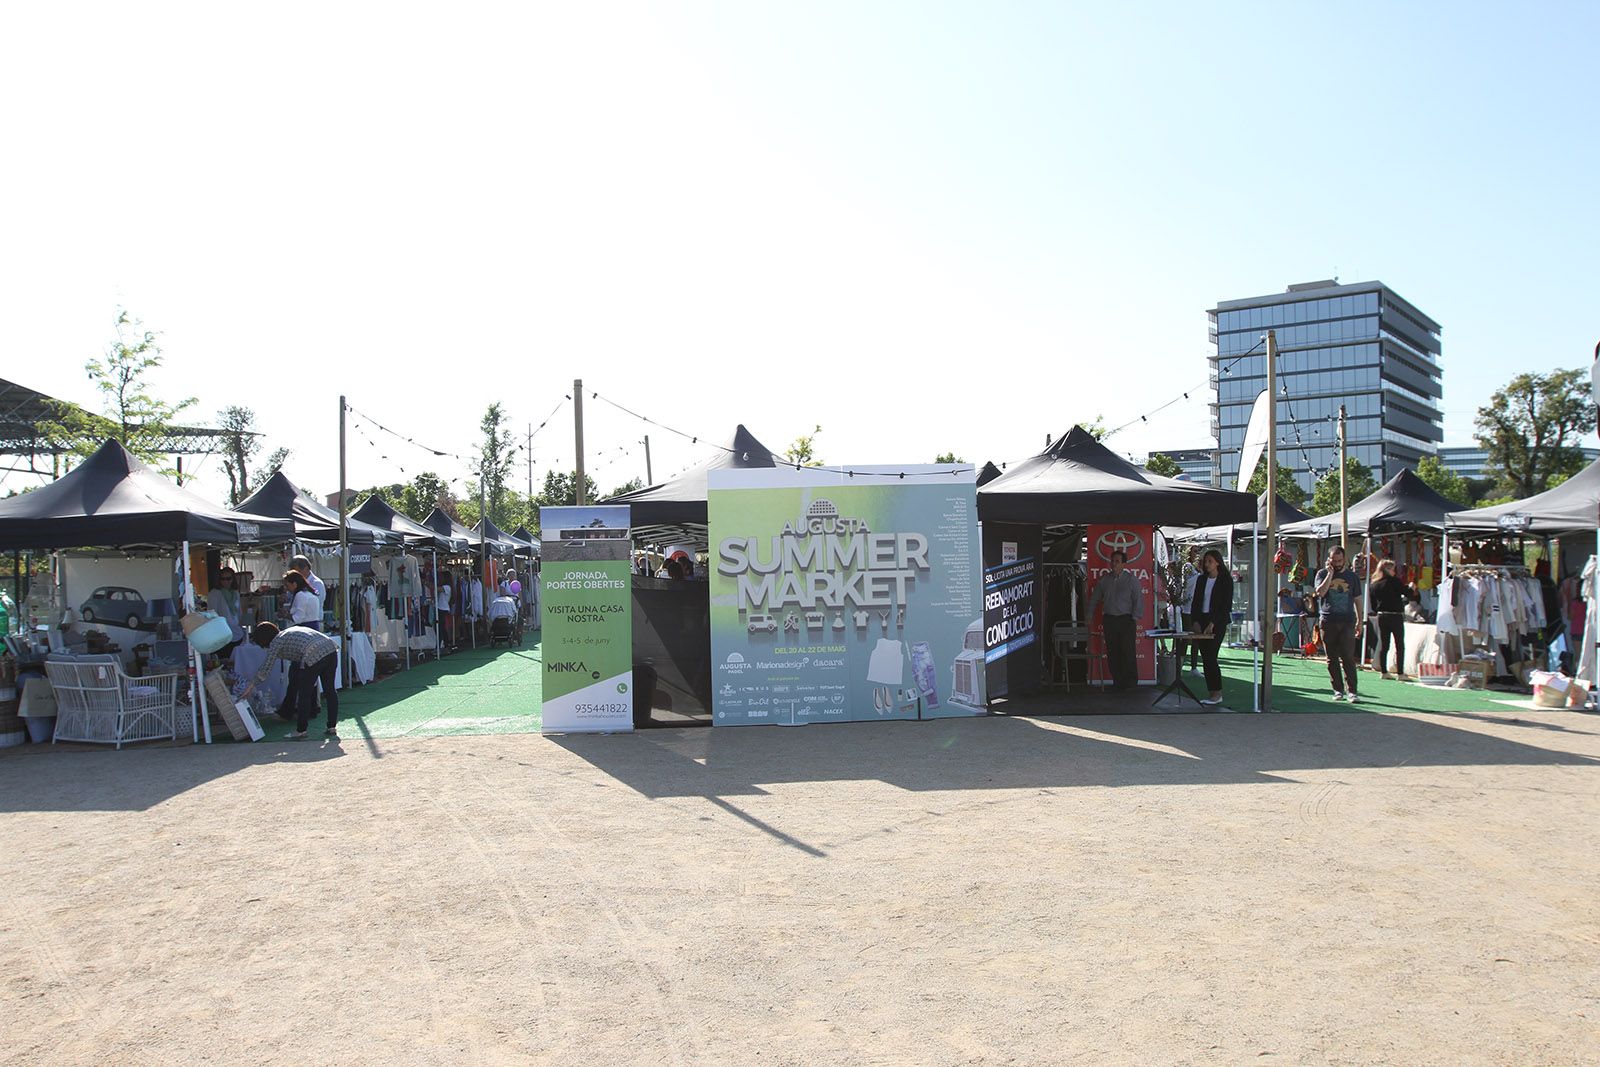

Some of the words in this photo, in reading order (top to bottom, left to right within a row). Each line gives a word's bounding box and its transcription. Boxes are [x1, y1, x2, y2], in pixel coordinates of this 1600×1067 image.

[781, 518, 871, 538] AUGUSTA
[718, 532, 930, 576] SUMMER
[563, 572, 608, 580] JORNADA
[1090, 568, 1149, 580] TOTA
[546, 581, 581, 590] PORTES
[583, 580, 625, 589] OBERTES
[737, 570, 915, 613] MARKET
[548, 606, 576, 614] VISITA
[578, 605, 598, 614] UNA
[600, 605, 624, 613] CASA
[1003, 607, 1010, 618] DE
[1010, 604, 1017, 615] LA
[567, 614, 605, 623] NOSTRA
[986, 605, 1034, 646] CONDUCCIÓ
[584, 636, 594, 644] de
[596, 637, 610, 646] juny
[548, 662, 587, 672] MINKA
[575, 704, 627, 713] 935441822
